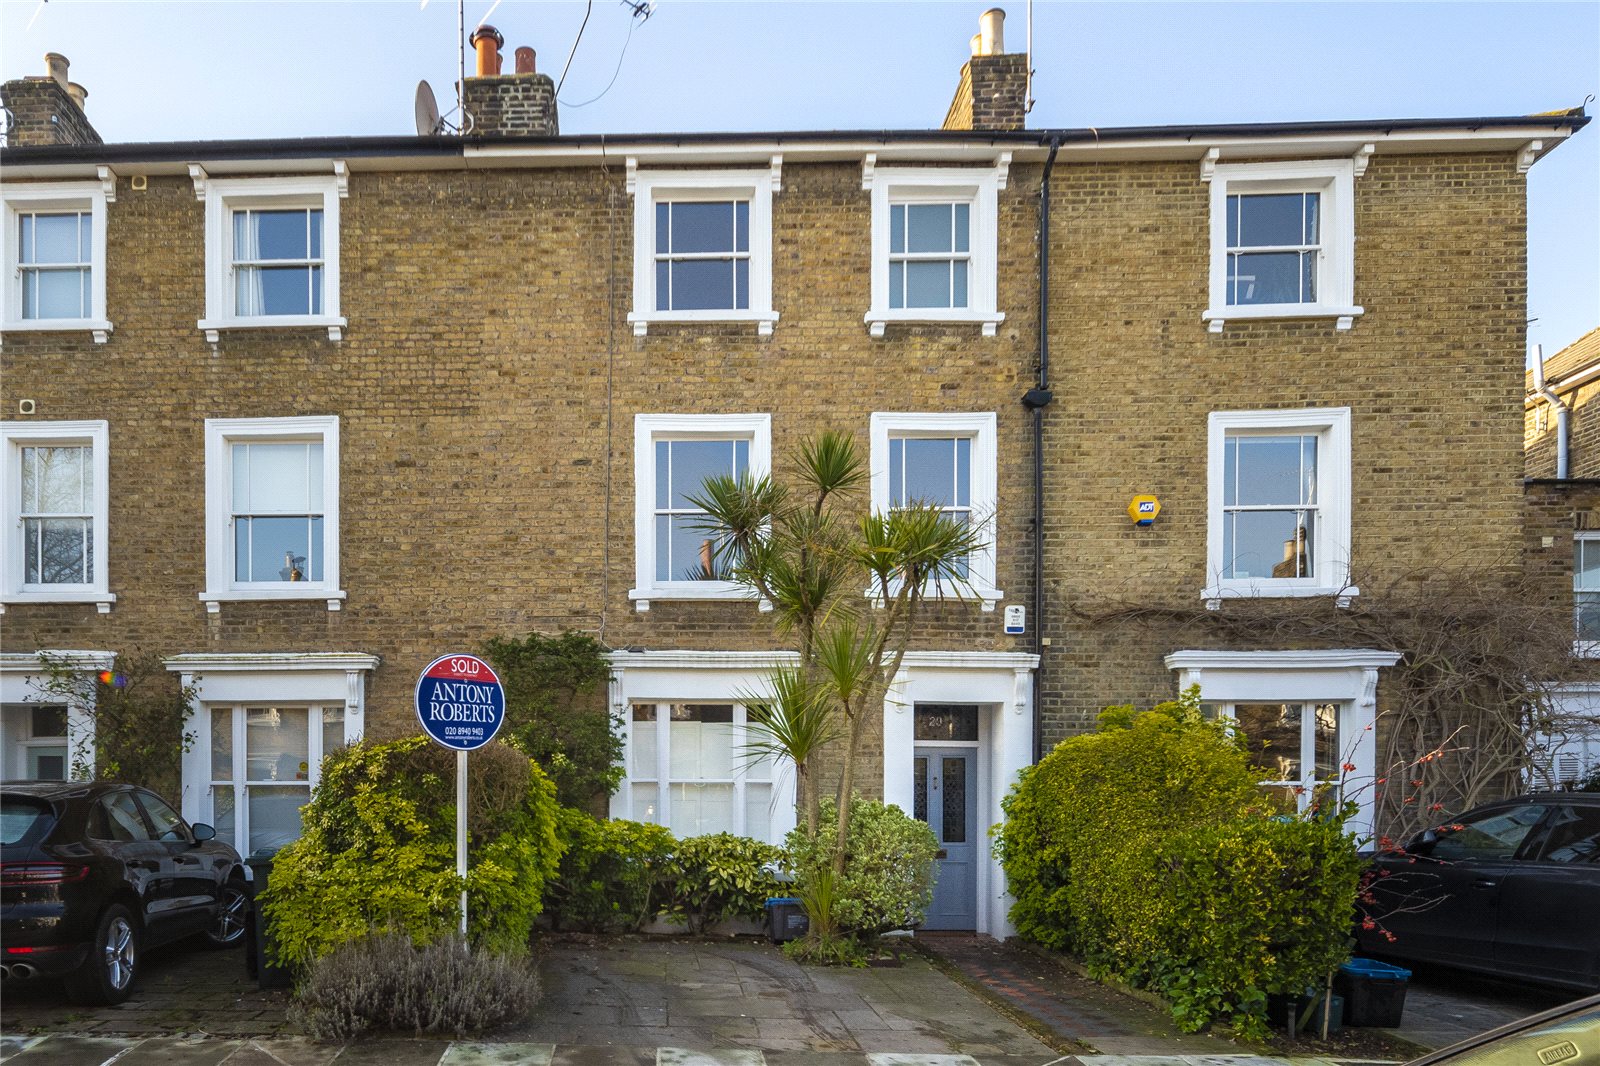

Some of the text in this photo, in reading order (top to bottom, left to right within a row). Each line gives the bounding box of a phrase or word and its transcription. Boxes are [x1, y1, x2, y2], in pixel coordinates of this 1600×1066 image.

[1140, 503, 1153, 511] ADT
[451, 659, 479, 674] SOLD
[431, 681, 494, 704] ANTONY
[429, 701, 495, 723] ROBERTS
[445, 726, 456, 735] 020
[457, 727, 471, 736] 8940
[1544, 1045, 1574, 1062] AIRBAG
